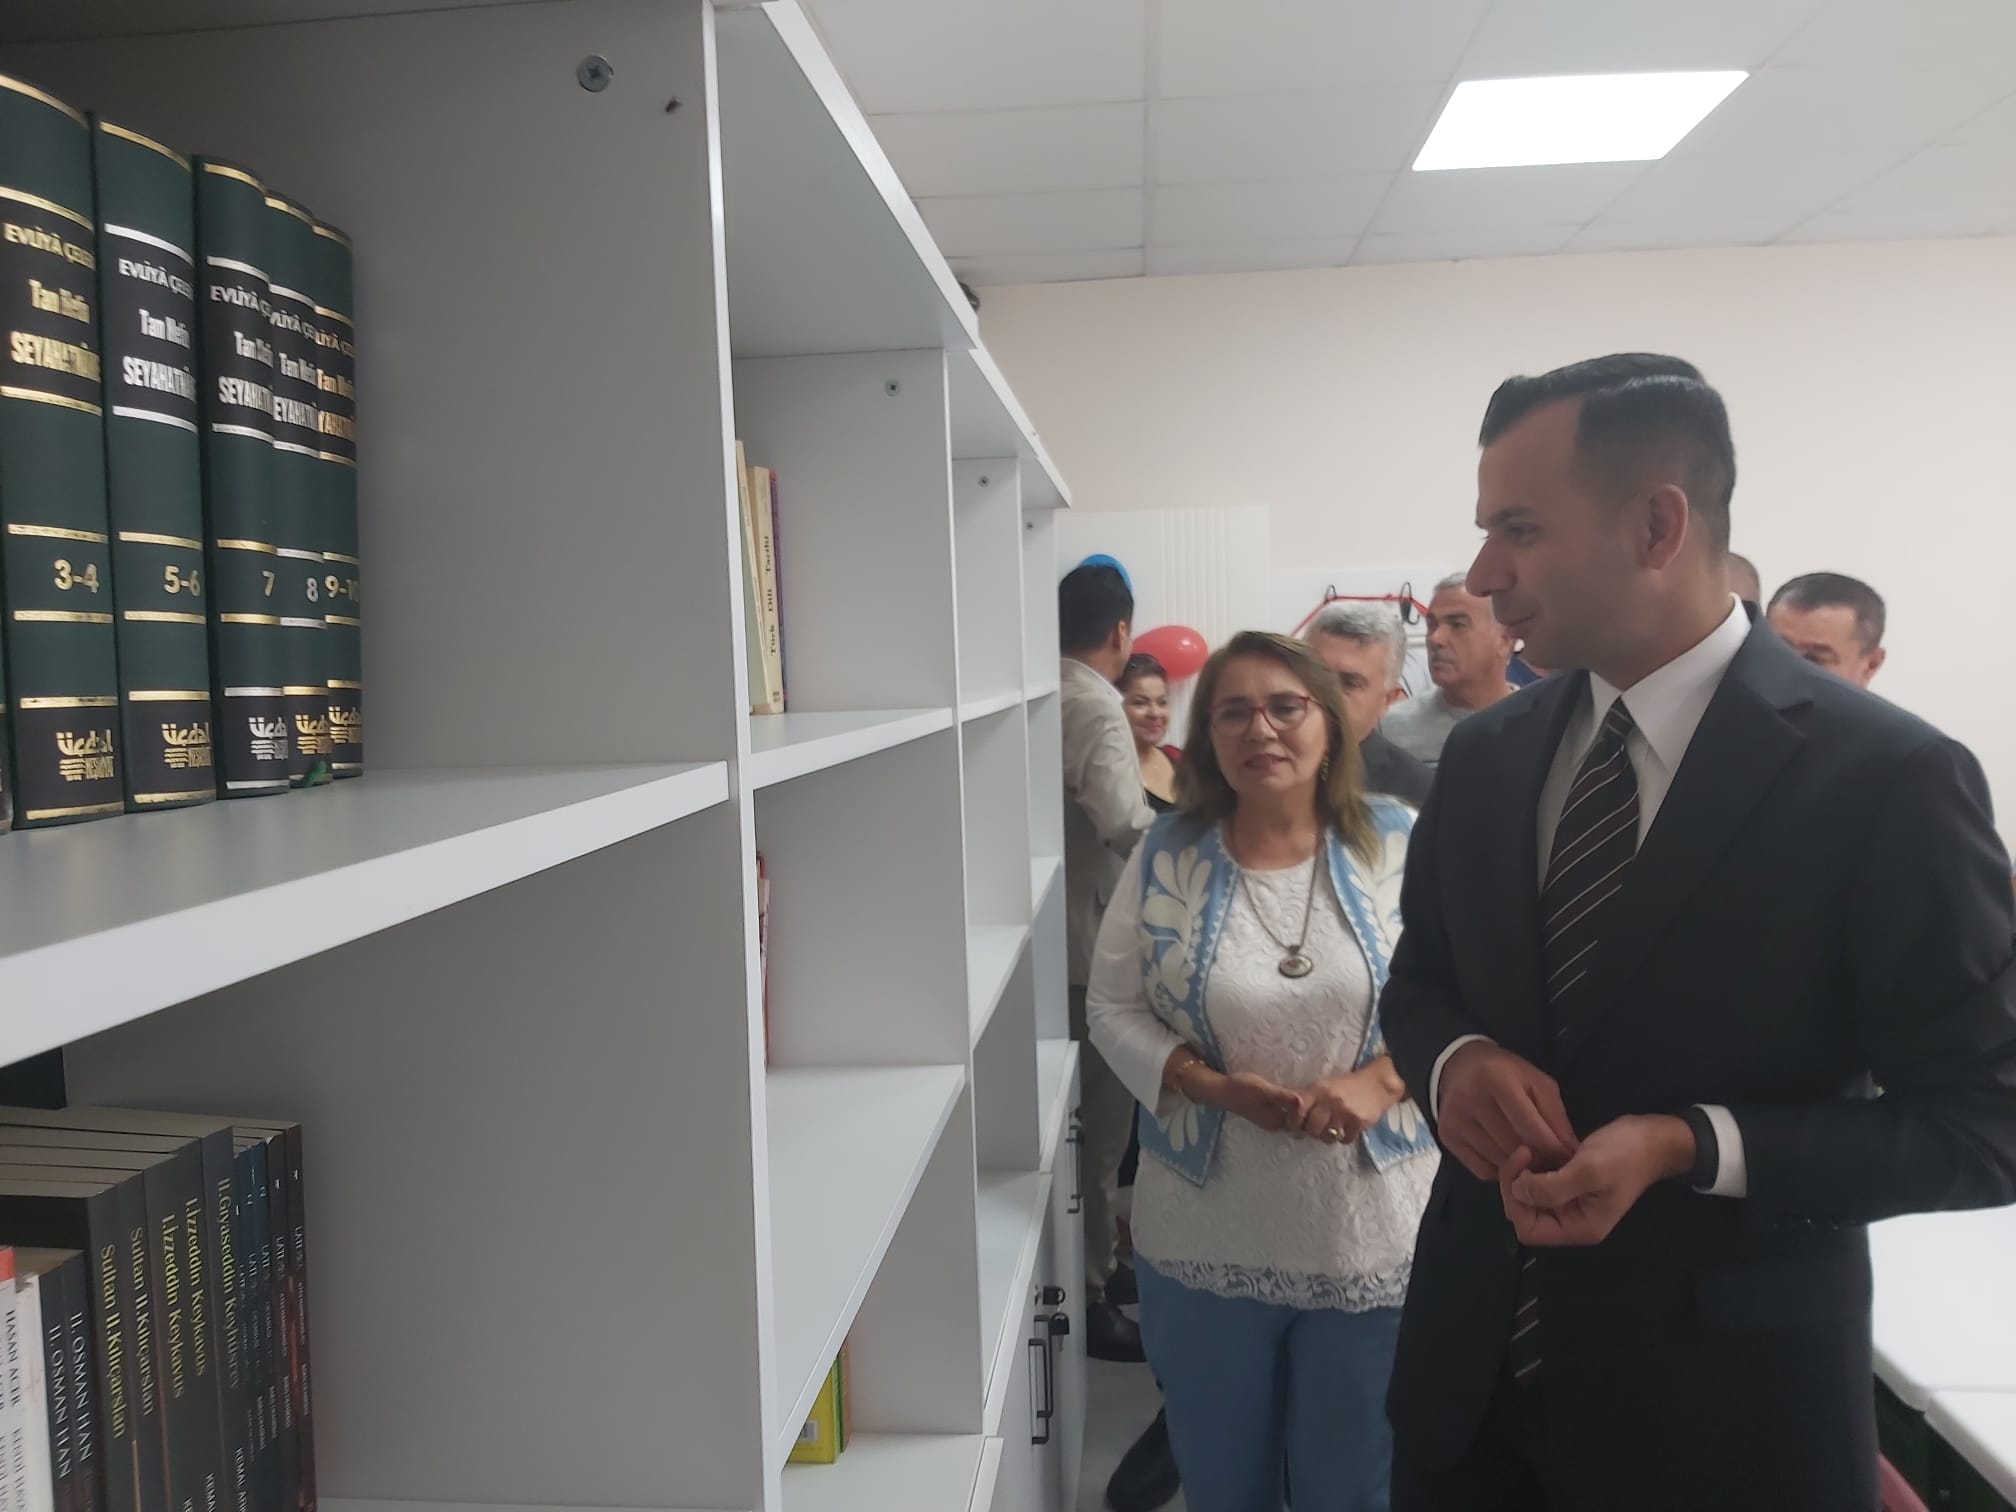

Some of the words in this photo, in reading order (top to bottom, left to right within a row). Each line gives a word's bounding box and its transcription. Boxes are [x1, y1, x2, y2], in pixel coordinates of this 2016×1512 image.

[27, 278, 59, 312] Tam
[139, 308, 165, 340] Tam
[234, 331, 256, 359] Tam
[54, 559, 99, 593] 3-4
[164, 565, 200, 596] 5-6
[262, 570, 275, 596] 7
[307, 577, 318, 602] 8
[100, 1243, 121, 1309] Sultan
[129, 1227, 148, 1291] Sultan
[4, 1309, 18, 1364] HASAN
[166, 1308, 186, 1399] Keykavus
[189, 1288, 208, 1377] Keykavus
[50, 1350, 69, 1425] OSMAN
[70, 1336, 89, 1410] OSMAN
[56, 1427, 73, 1480] HAN
[76, 1412, 93, 1462] HAN
[234, 1447, 246, 1489] KEMAL
